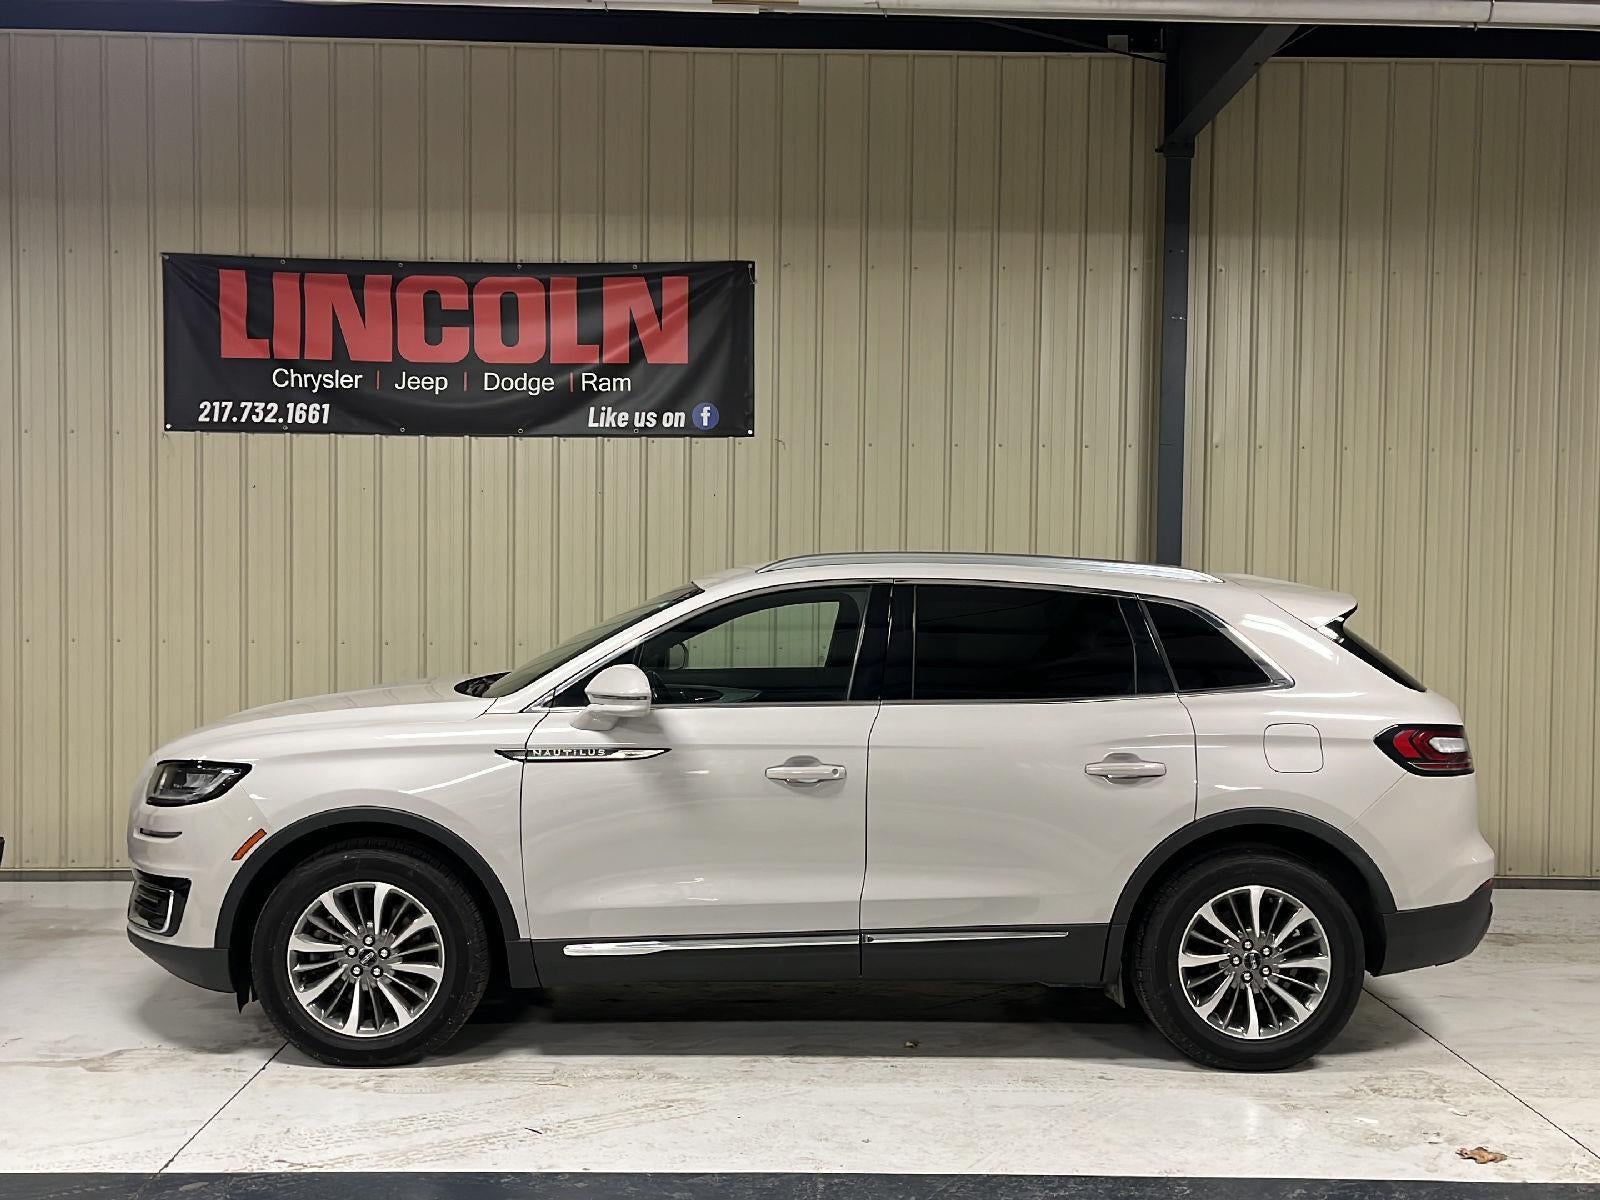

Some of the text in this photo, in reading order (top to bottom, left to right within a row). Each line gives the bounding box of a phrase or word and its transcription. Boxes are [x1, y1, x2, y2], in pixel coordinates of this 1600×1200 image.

[218, 269, 689, 365] LINCOLN
[272, 368, 632, 396] Chrysler Jeep Dodge Ram
[197, 401, 330, 425] 217.732.1661
[587, 405, 630, 428] Like
[634, 411, 658, 428] us
[661, 411, 686, 428] on
[532, 749, 606, 757] NAUTILUS
